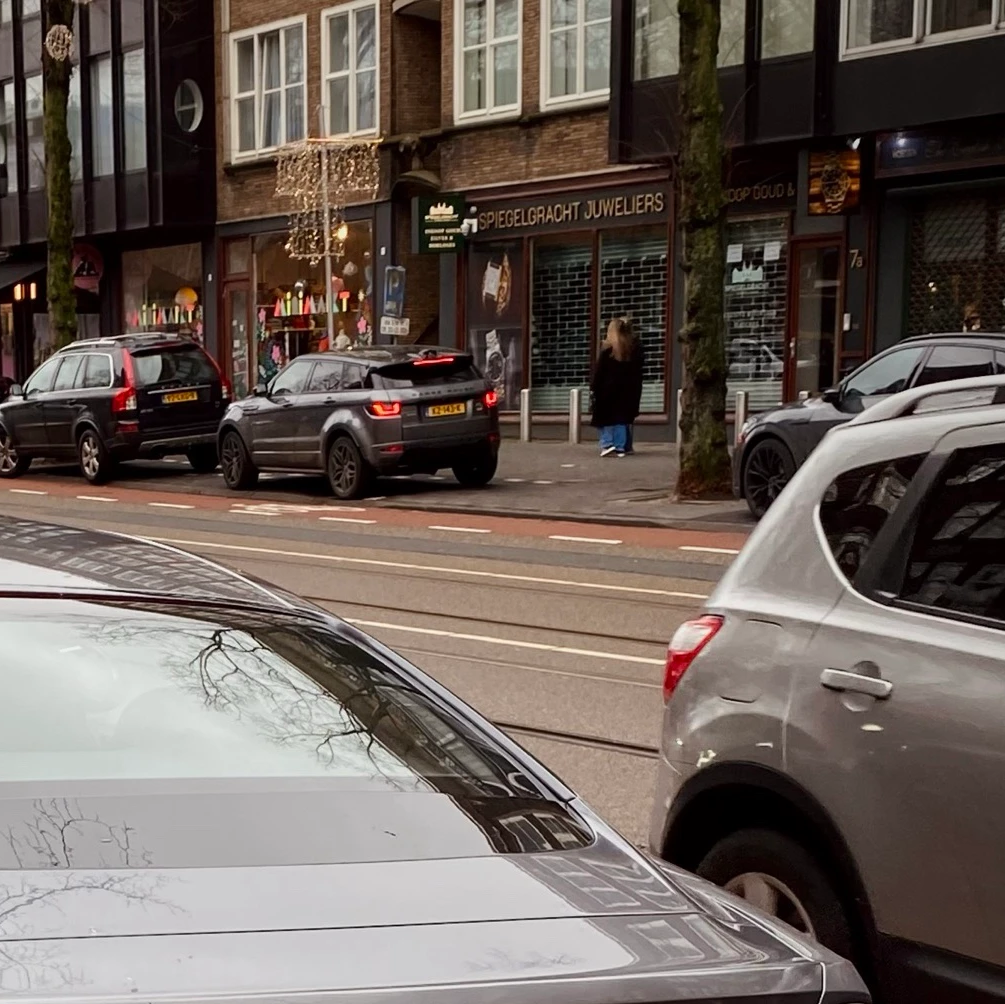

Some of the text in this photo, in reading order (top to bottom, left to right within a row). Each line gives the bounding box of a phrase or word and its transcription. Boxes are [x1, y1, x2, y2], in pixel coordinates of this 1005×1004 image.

[478, 192, 664, 231] SPIEGELGRACHT JUWELIERS
[848, 248, 863, 269] 7a
